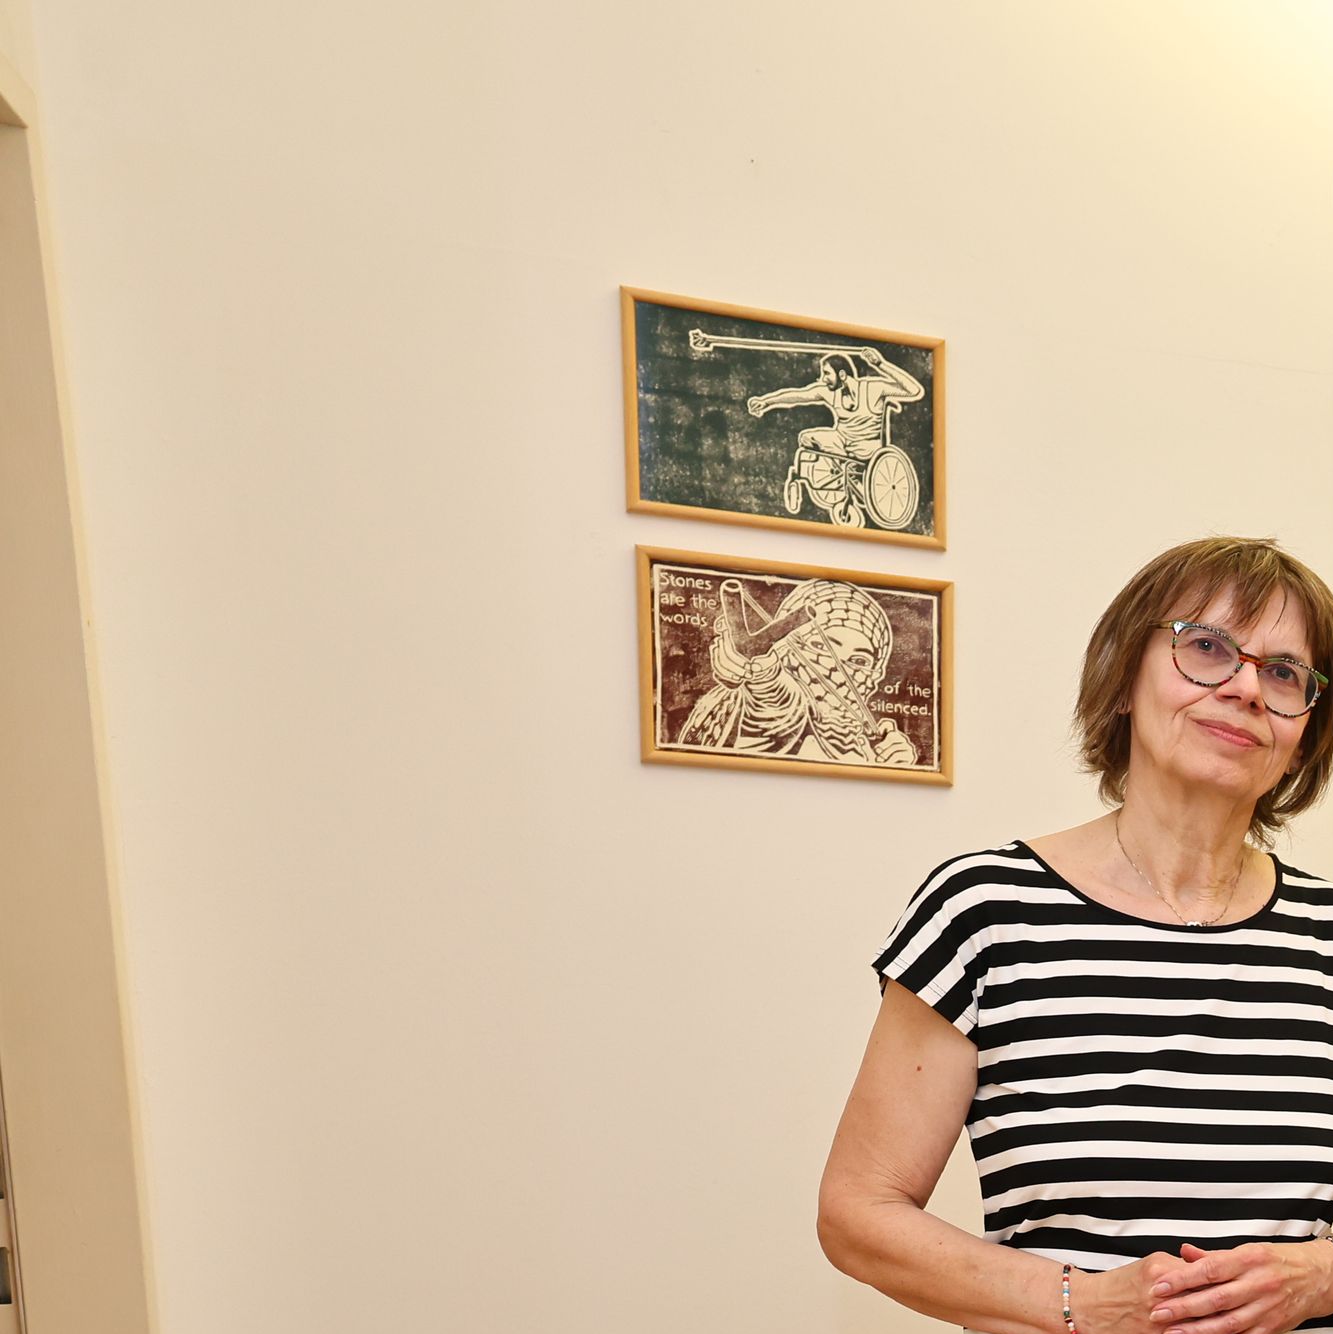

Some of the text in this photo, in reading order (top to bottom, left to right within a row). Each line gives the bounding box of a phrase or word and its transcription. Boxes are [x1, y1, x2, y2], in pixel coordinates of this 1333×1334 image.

[660, 572, 712, 590] Stones
[660, 592, 718, 610] are the
[660, 612, 708, 627] words
[884, 681, 931, 698] of the
[870, 699, 932, 716] silenced.
